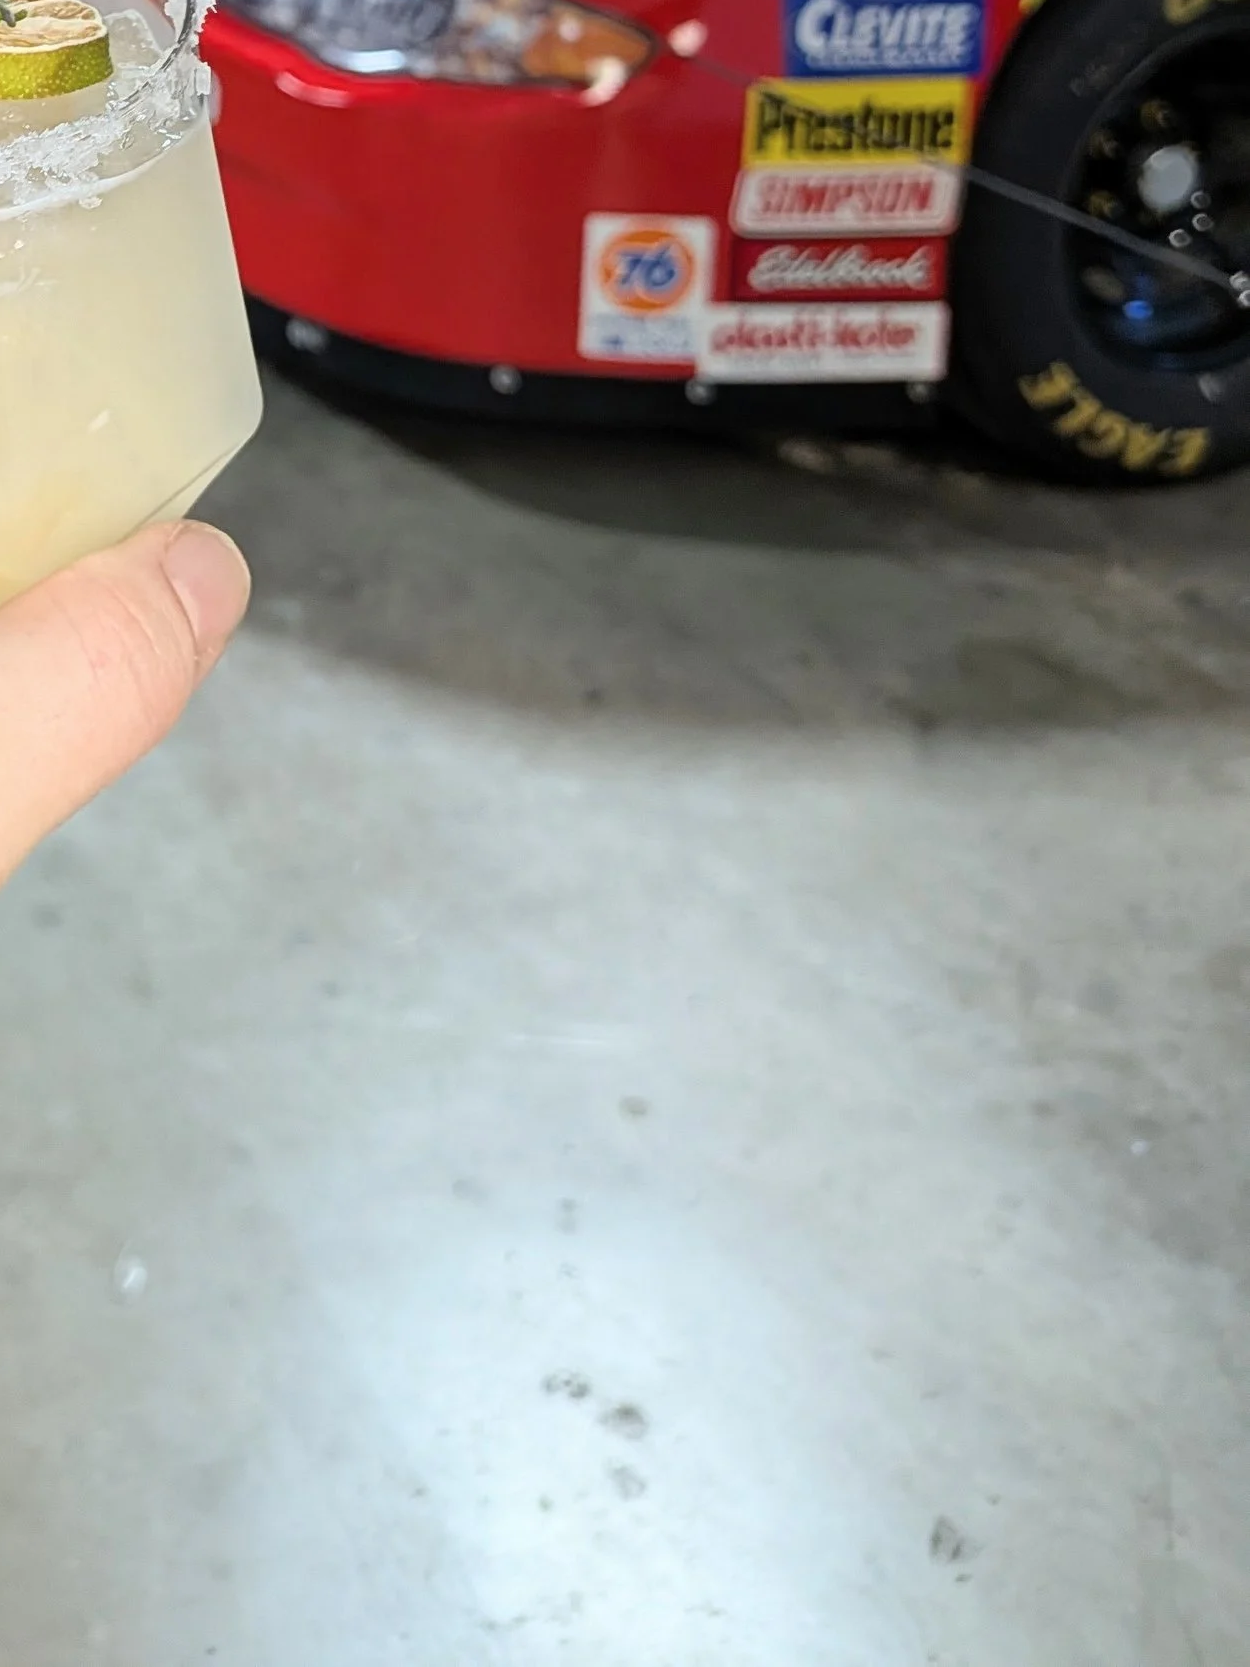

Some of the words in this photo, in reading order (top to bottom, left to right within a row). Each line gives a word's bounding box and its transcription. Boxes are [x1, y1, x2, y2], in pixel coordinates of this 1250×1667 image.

[756, 90, 956, 157] Prestone
[758, 174, 935, 215] SIMPSON
[618, 242, 682, 290] 76
[1017, 360, 1209, 476] EAGLE
